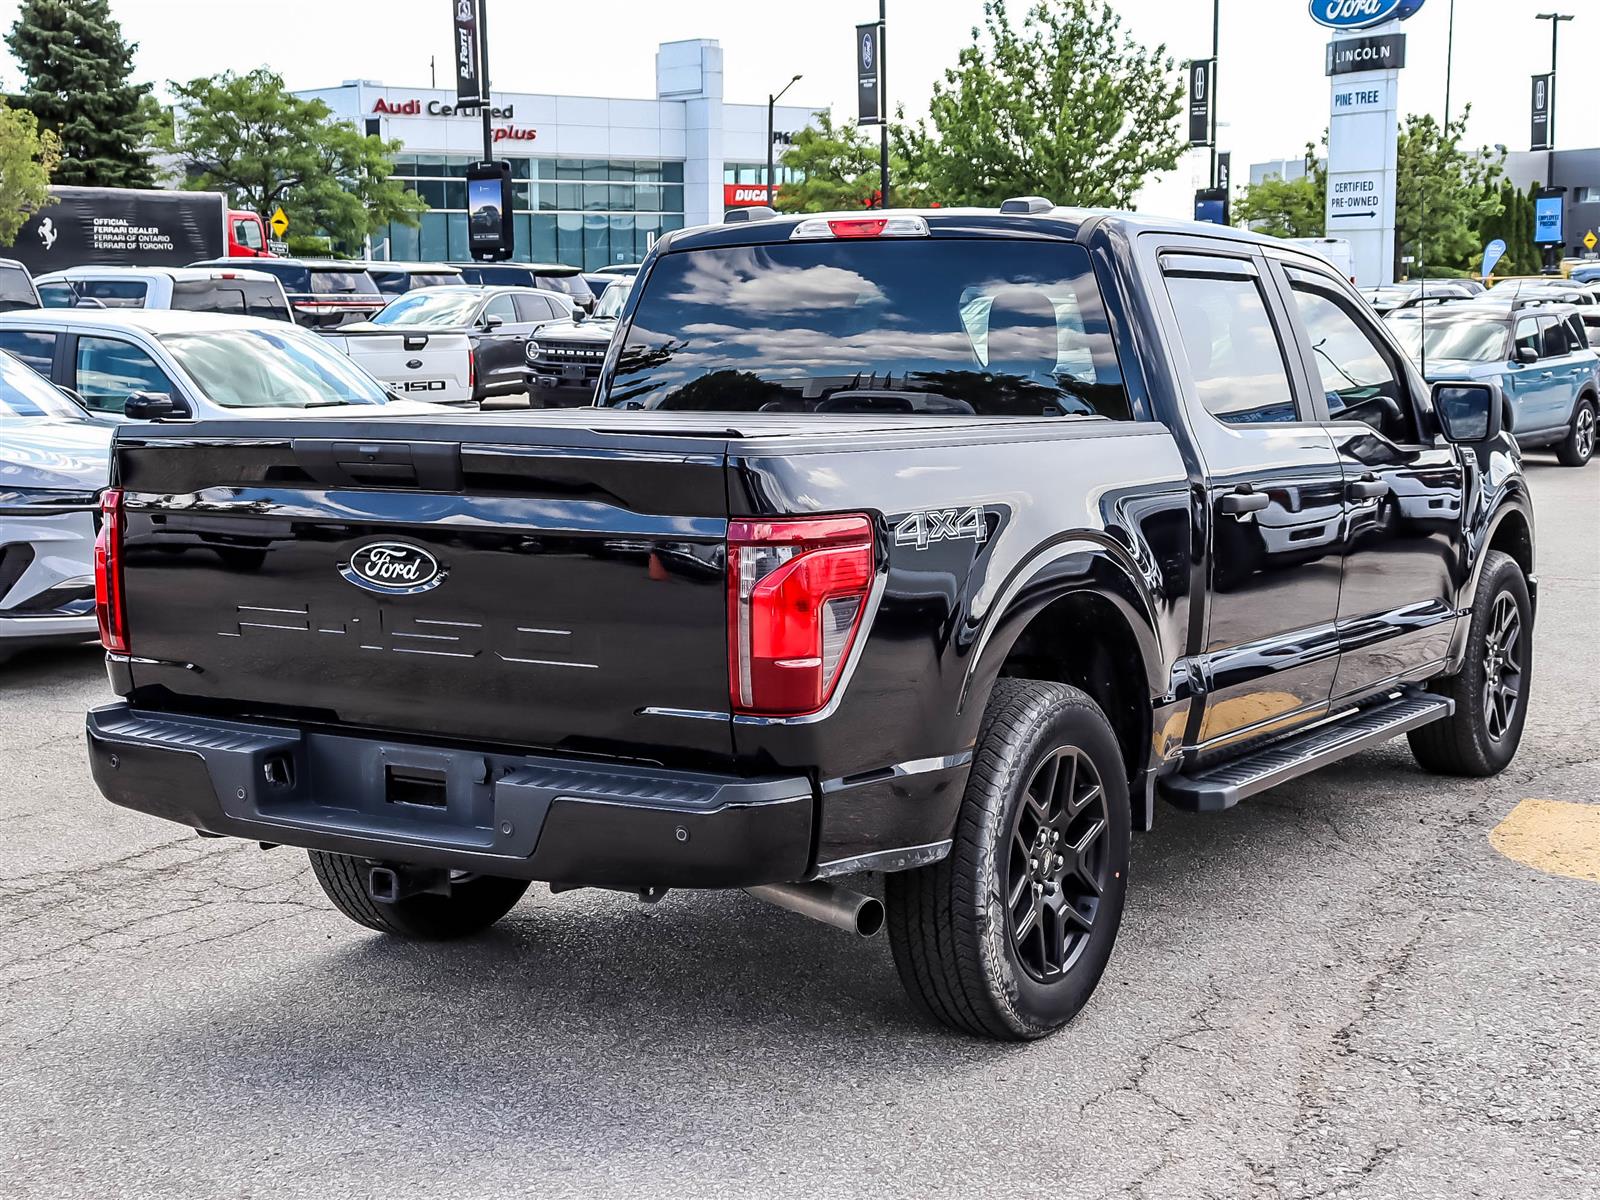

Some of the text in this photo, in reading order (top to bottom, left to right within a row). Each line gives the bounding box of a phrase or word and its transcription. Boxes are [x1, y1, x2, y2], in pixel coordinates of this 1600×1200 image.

[1326, 0, 1381, 19] Ford
[1336, 45, 1391, 63] LINCOLN
[1335, 90, 1379, 107] PINE TREE
[372, 98, 421, 115] Audi
[1335, 181, 1374, 193] CERTIFIED
[735, 189, 778, 201] DUCA
[1331, 196, 1379, 208] PRE-OWNED
[93, 218, 129, 226] OFFICIAL
[93, 226, 127, 234] FERRARI
[365, 548, 421, 580] Ford
